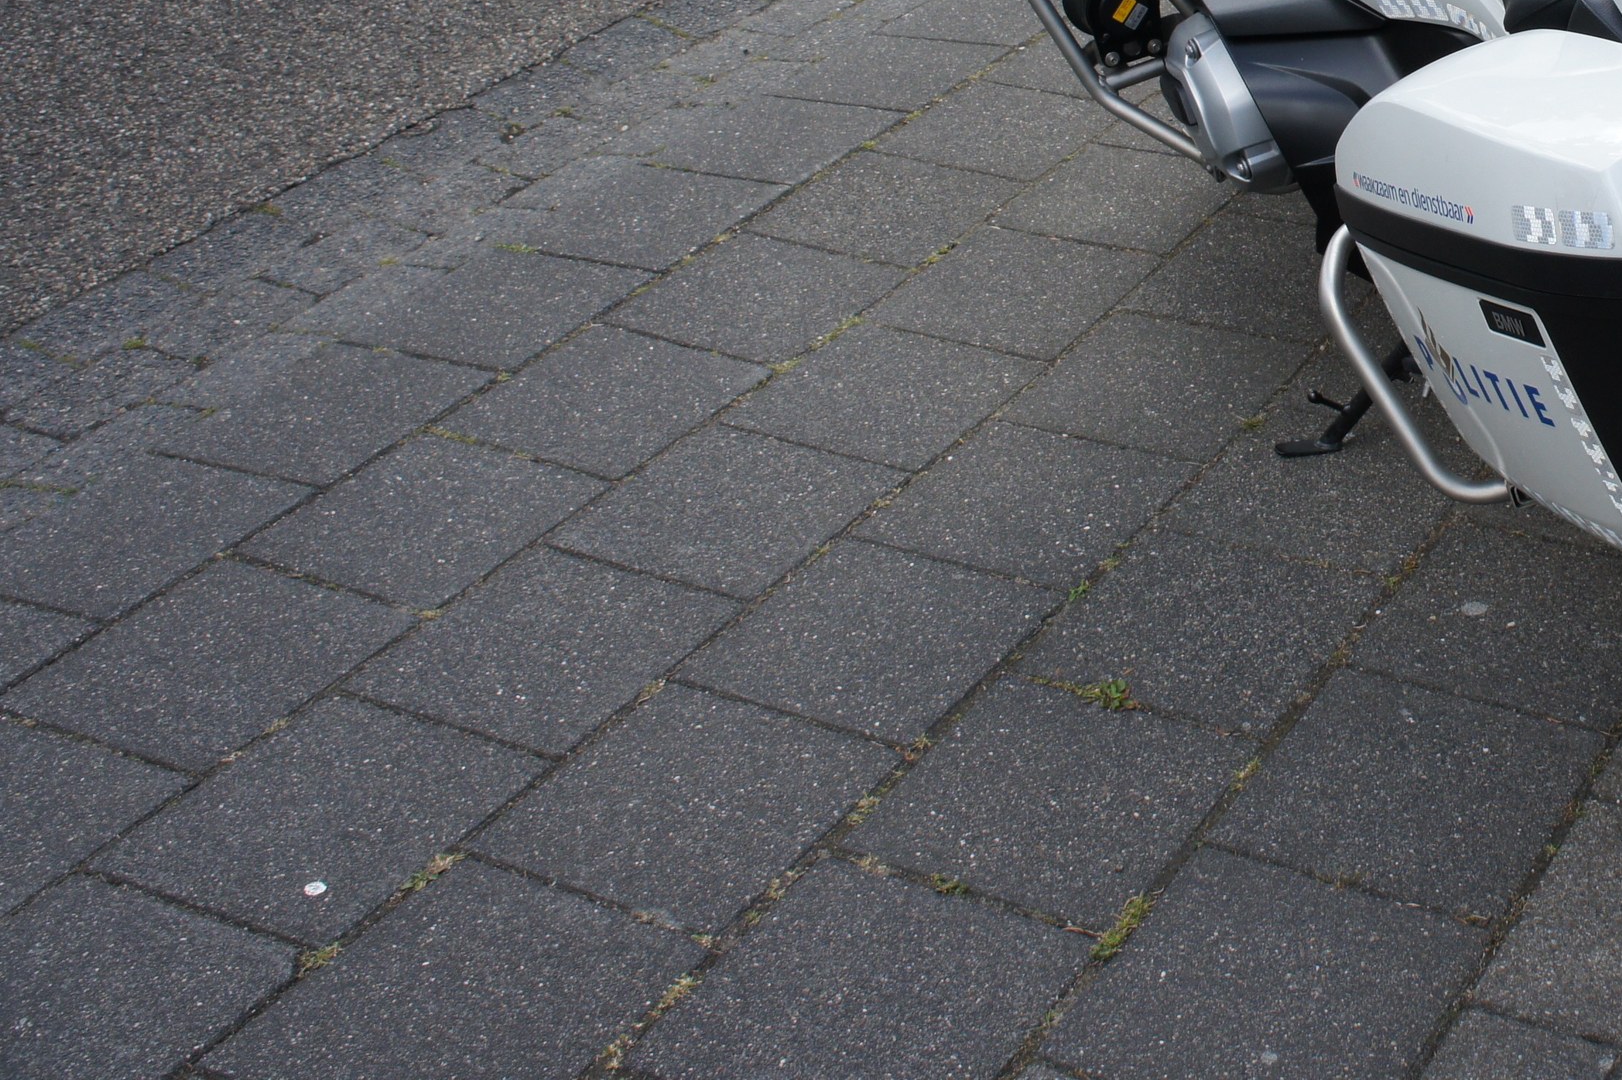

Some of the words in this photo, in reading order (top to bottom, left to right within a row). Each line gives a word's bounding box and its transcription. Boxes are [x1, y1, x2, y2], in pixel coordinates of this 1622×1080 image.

[1398, 186, 1411, 207] en
[1491, 311, 1526, 337] BMW
[1413, 335, 1556, 427] POLITIE
